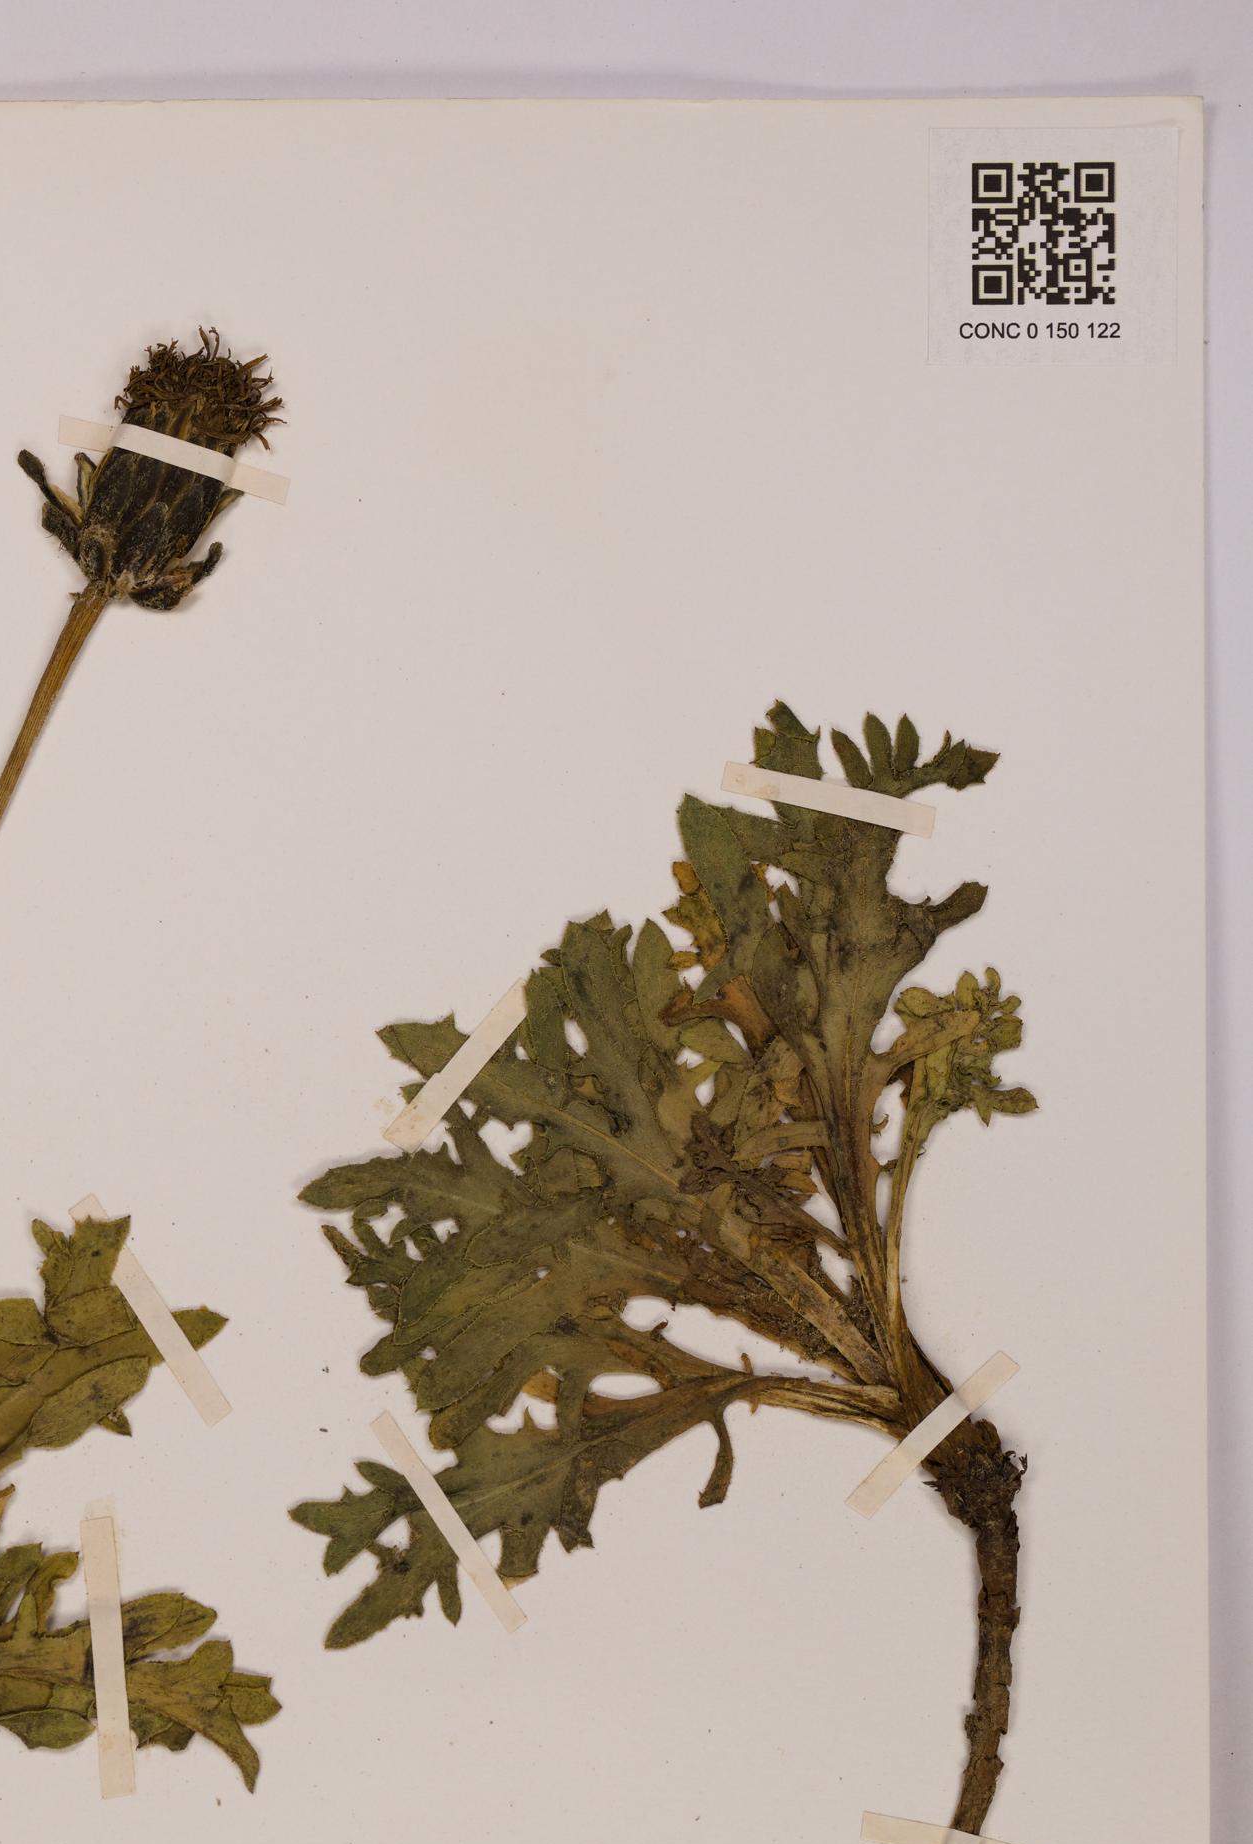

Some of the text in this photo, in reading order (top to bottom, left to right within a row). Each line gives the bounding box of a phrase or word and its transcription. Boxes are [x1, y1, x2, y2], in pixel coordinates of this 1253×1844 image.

[959, 322, 1121, 340] CONC 0 150 122
